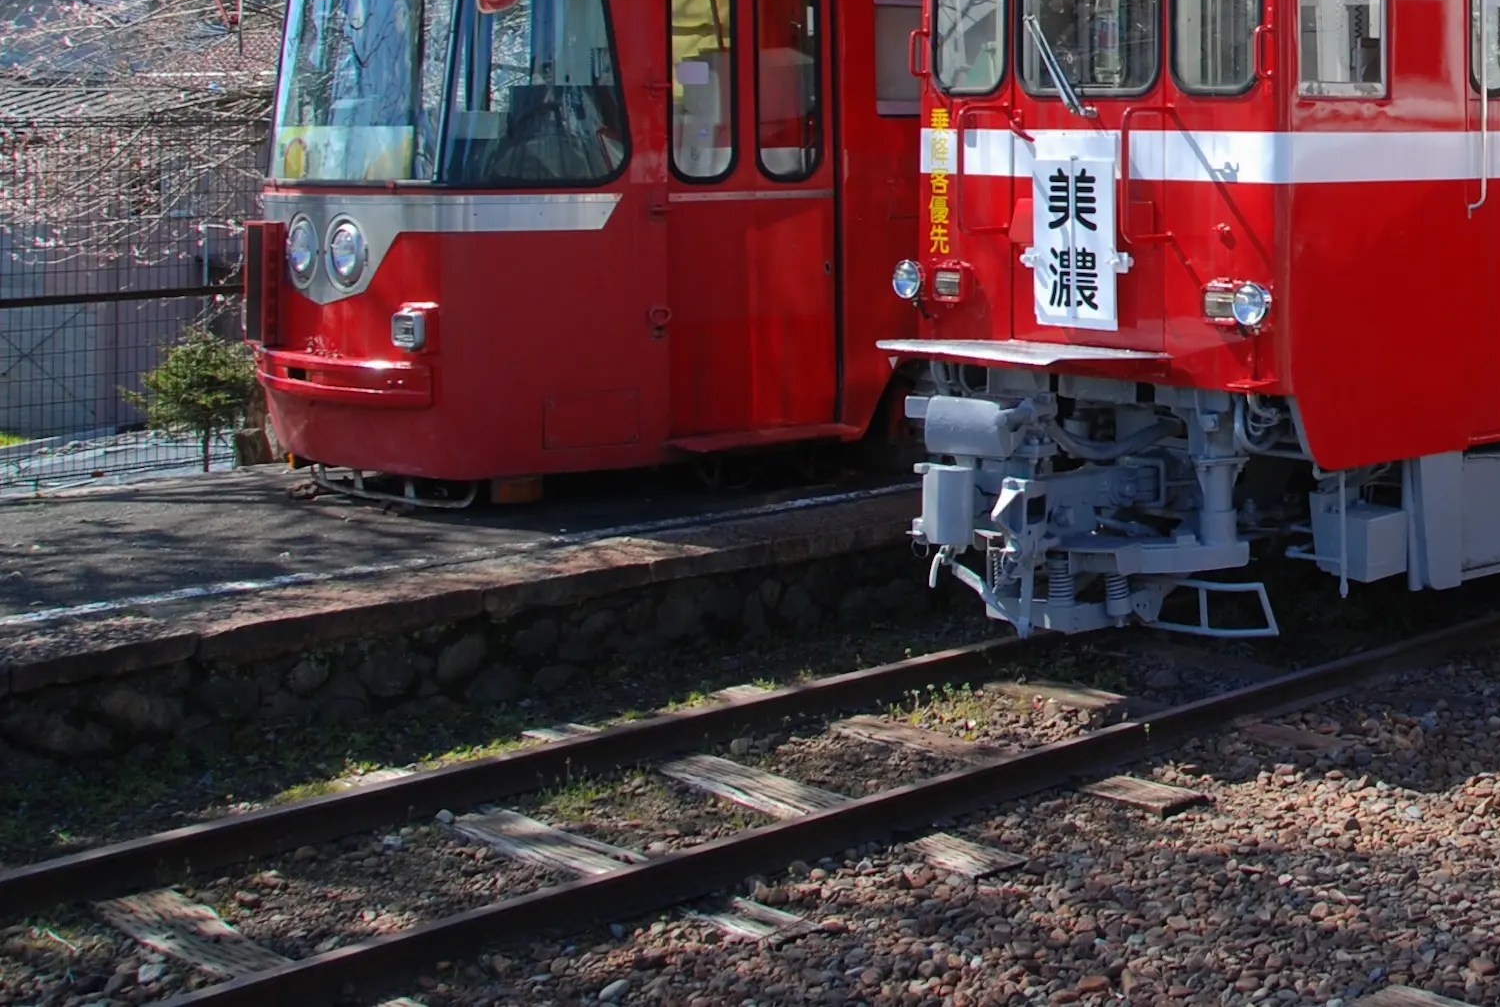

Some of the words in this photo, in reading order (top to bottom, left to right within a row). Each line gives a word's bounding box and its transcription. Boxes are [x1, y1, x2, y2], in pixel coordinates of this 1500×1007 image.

[929, 108, 949, 254] 乗降客優先
[1048, 167, 1098, 310] 美濃
